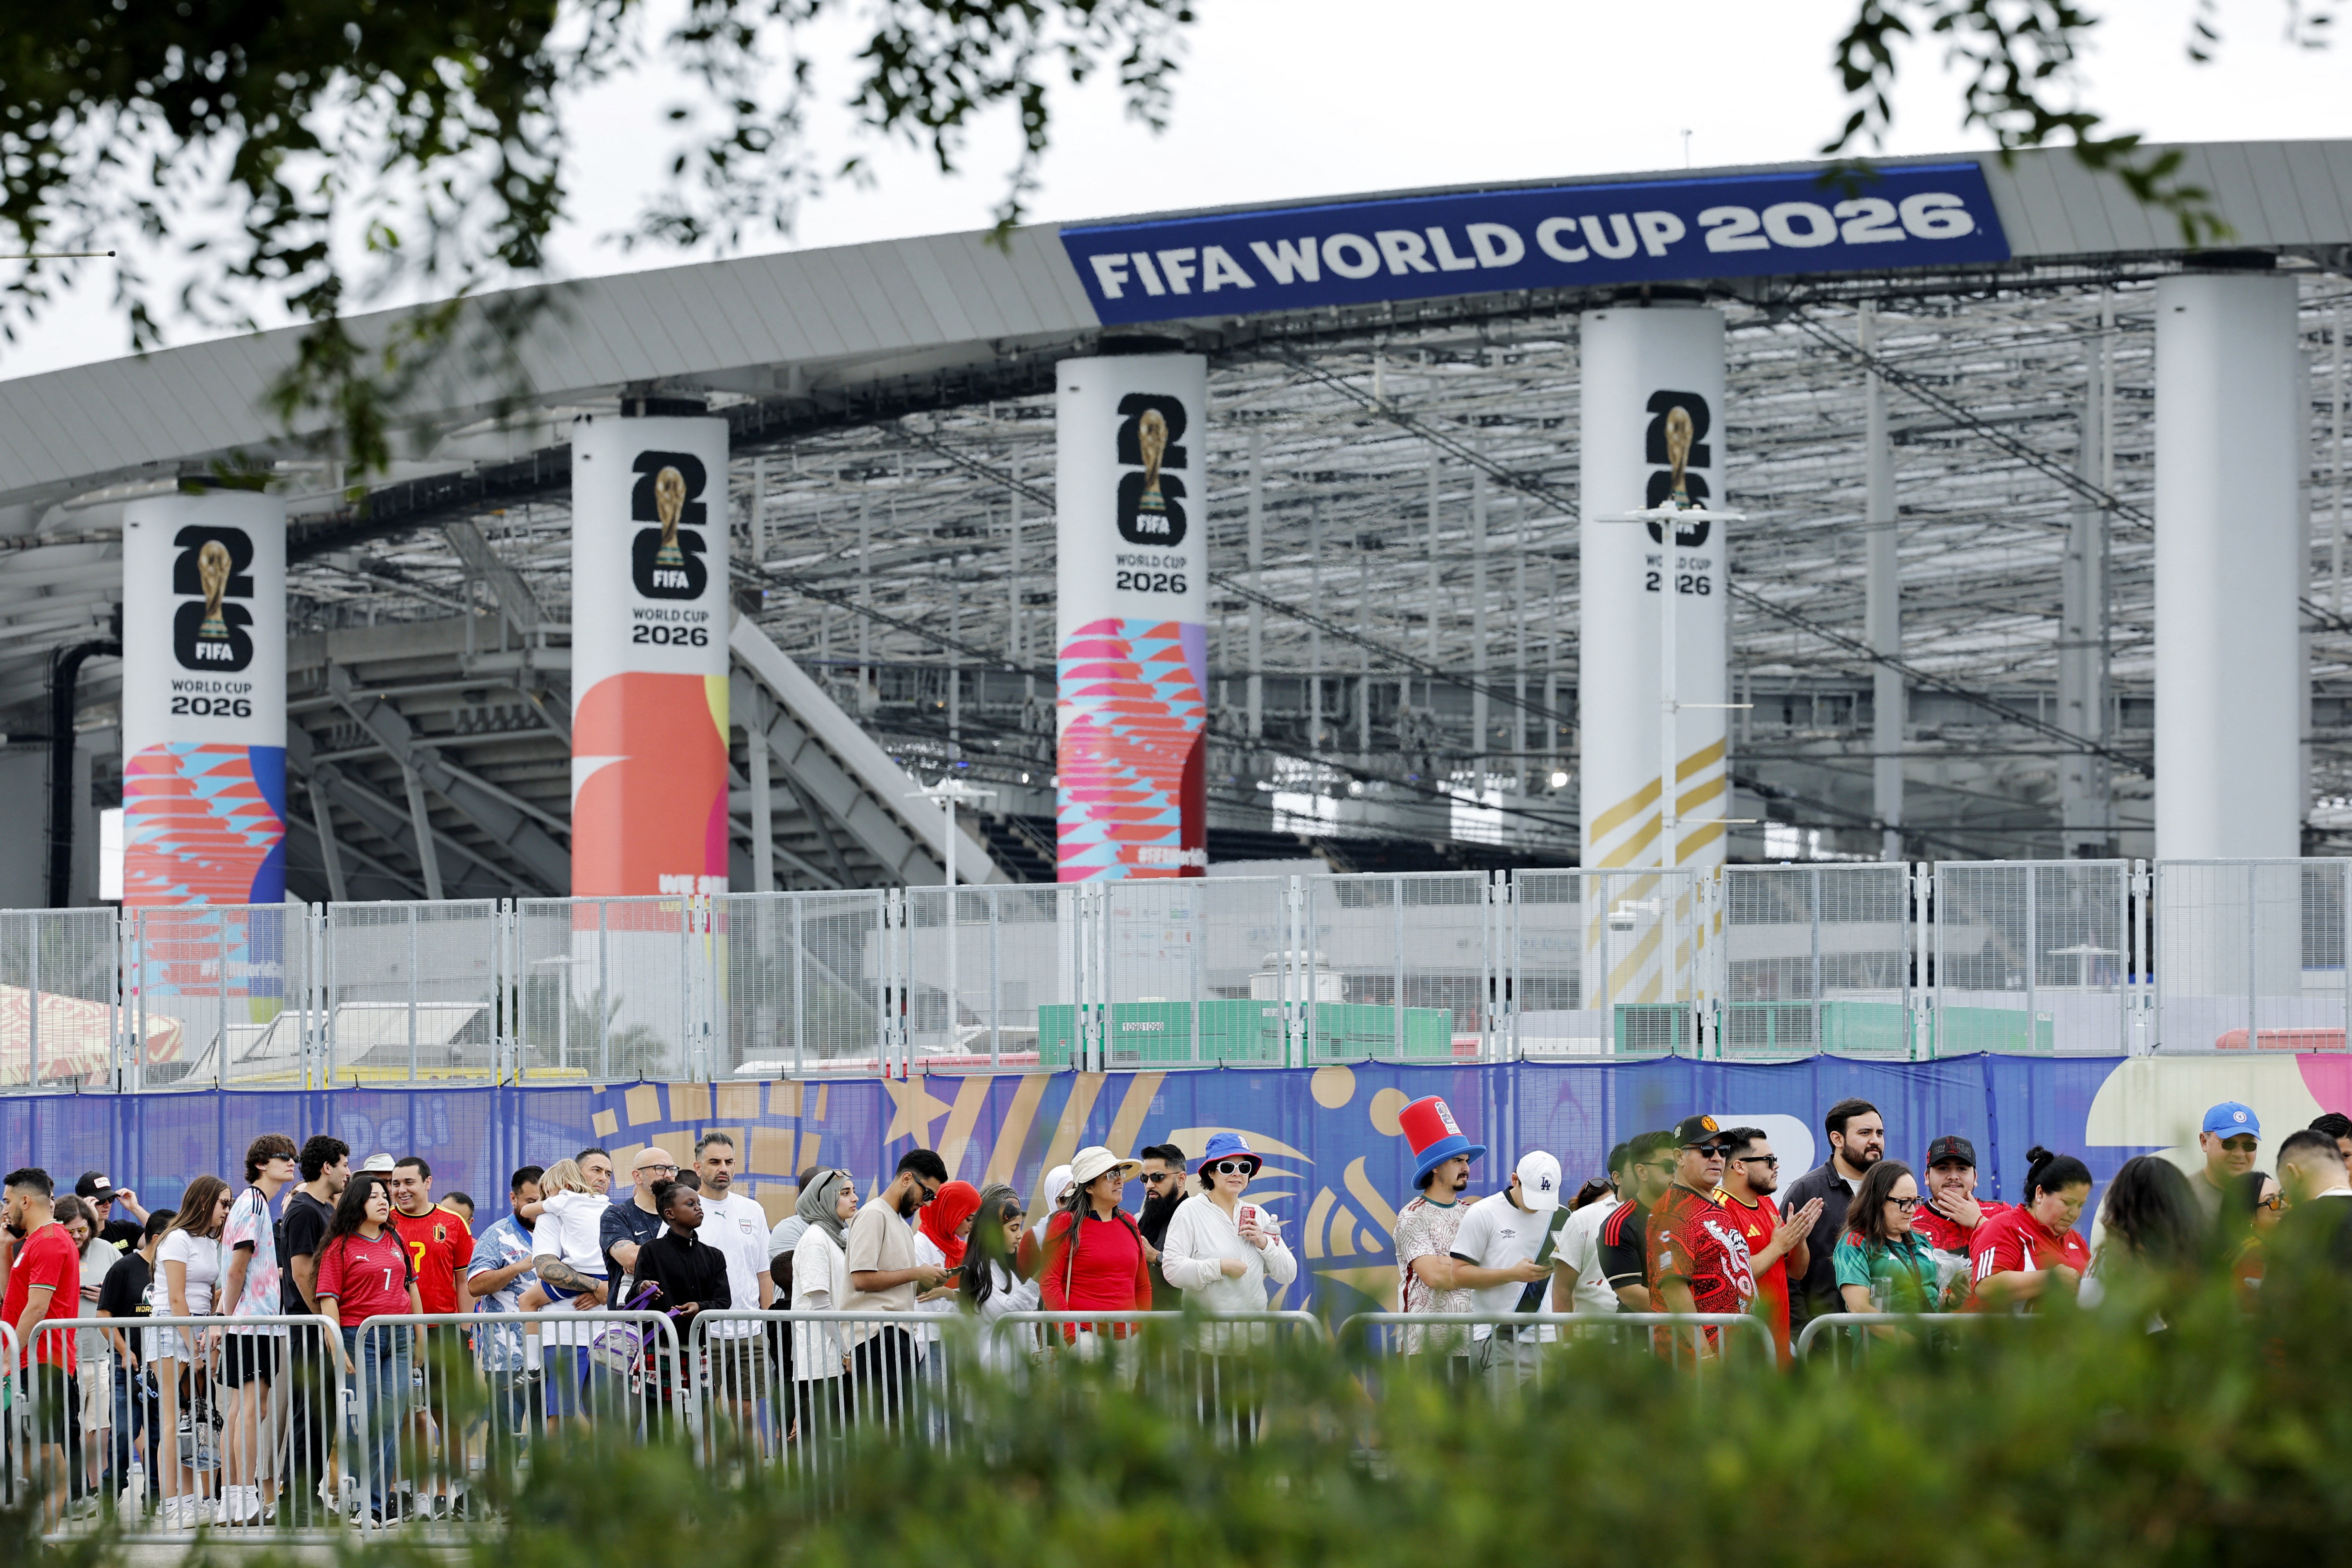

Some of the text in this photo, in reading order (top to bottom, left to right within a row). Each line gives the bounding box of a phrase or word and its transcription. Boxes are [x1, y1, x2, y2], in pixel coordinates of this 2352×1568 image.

[1089, 193, 1974, 298] FIFA WORLD CUP 2026
[1136, 514, 1170, 535] FIFA
[1116, 554, 1187, 569] WORLD CUP
[1690, 557, 1711, 570] CUP
[653, 570, 689, 588] FIFA
[1116, 571, 1188, 595] 2026
[1646, 571, 1711, 596] 226
[633, 608, 709, 622] WORLD CUP
[632, 624, 709, 648] 2026
[196, 642, 234, 661] FIFA
[172, 680, 252, 694] WORLD CUP
[171, 696, 252, 718] 2026
[659, 873, 695, 895] WE
[1541, 1176, 1551, 1191] LA
[409, 1241, 425, 1273] 7
